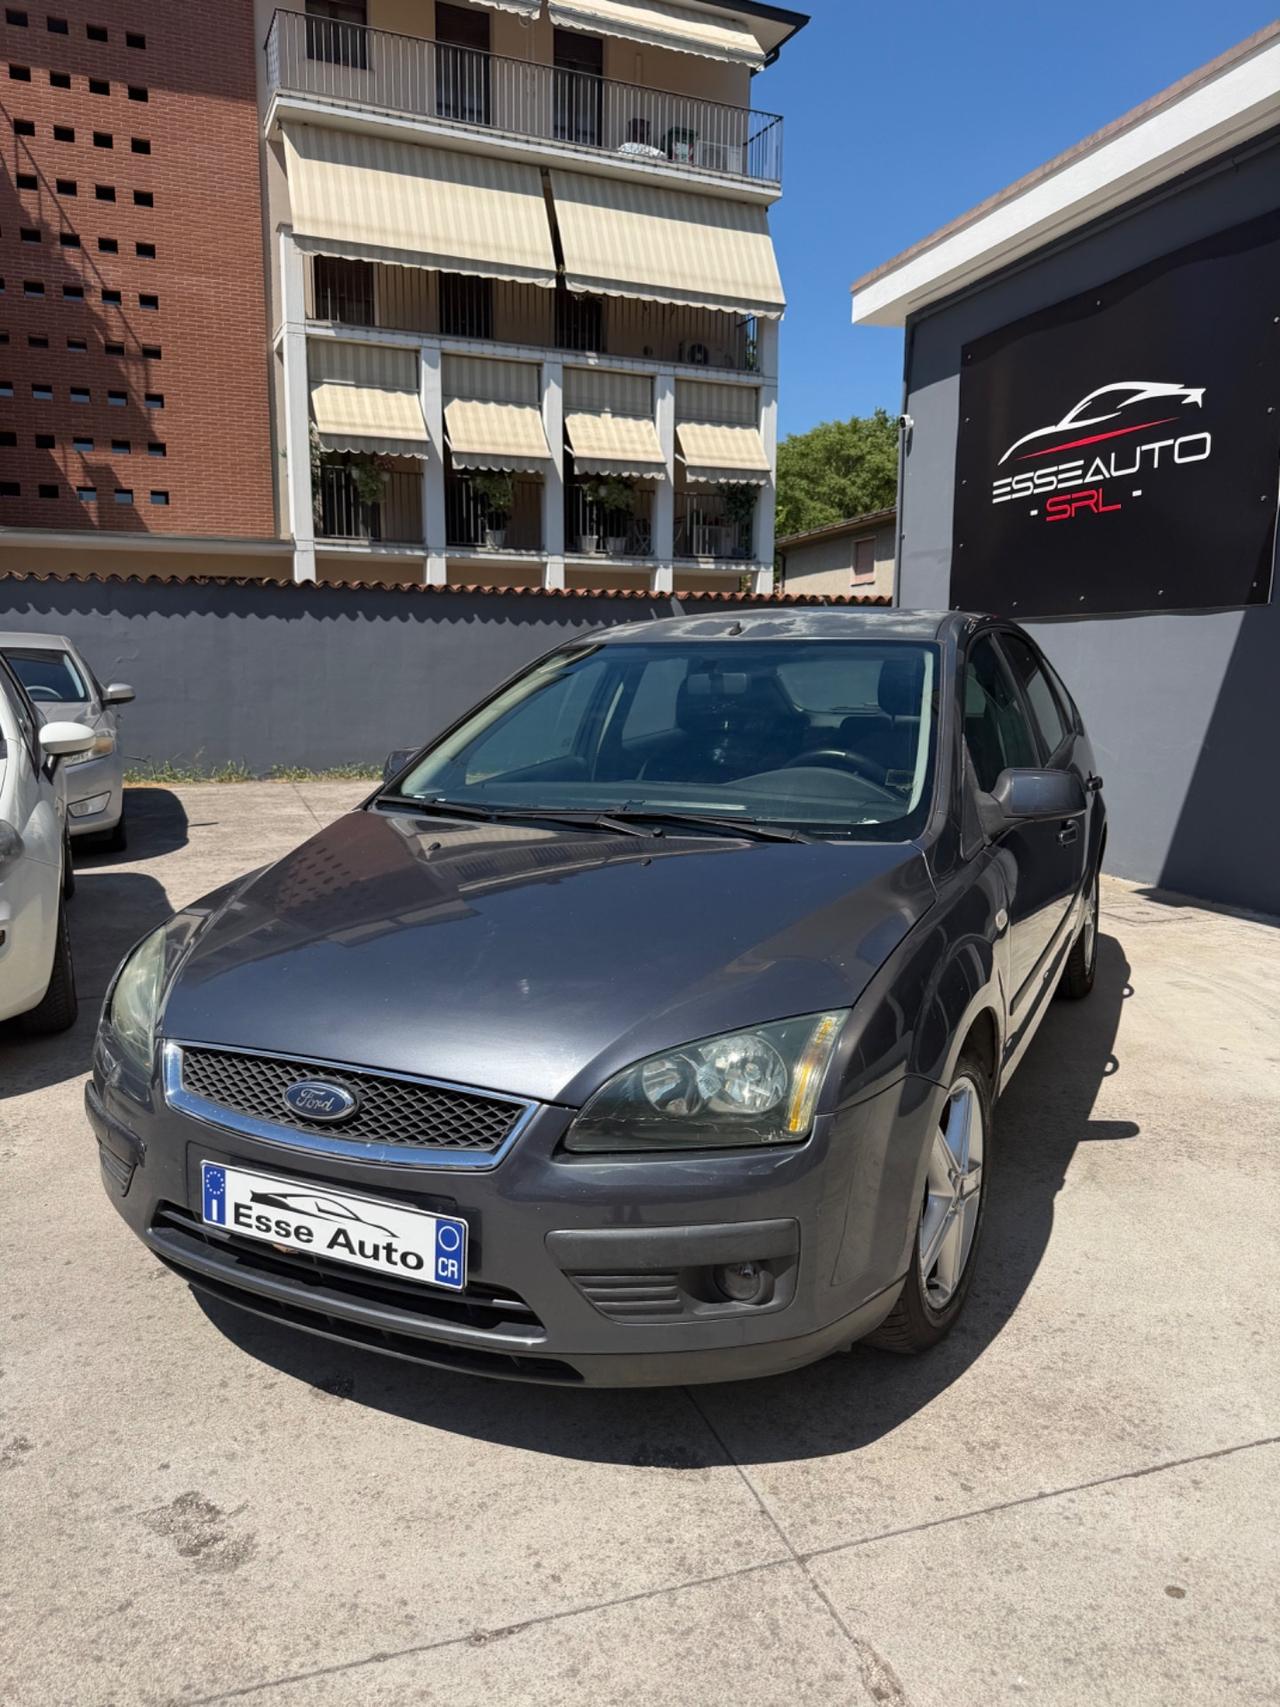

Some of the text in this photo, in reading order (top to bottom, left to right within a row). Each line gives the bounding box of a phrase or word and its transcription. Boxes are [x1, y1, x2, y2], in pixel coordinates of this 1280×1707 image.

[992, 432, 1212, 504] ESSEAUTO
[1046, 488, 1122, 522] SRL
[295, 1088, 336, 1111] Ford
[233, 1202, 424, 1271] Esse Auto
[437, 1258, 459, 1280] CR
